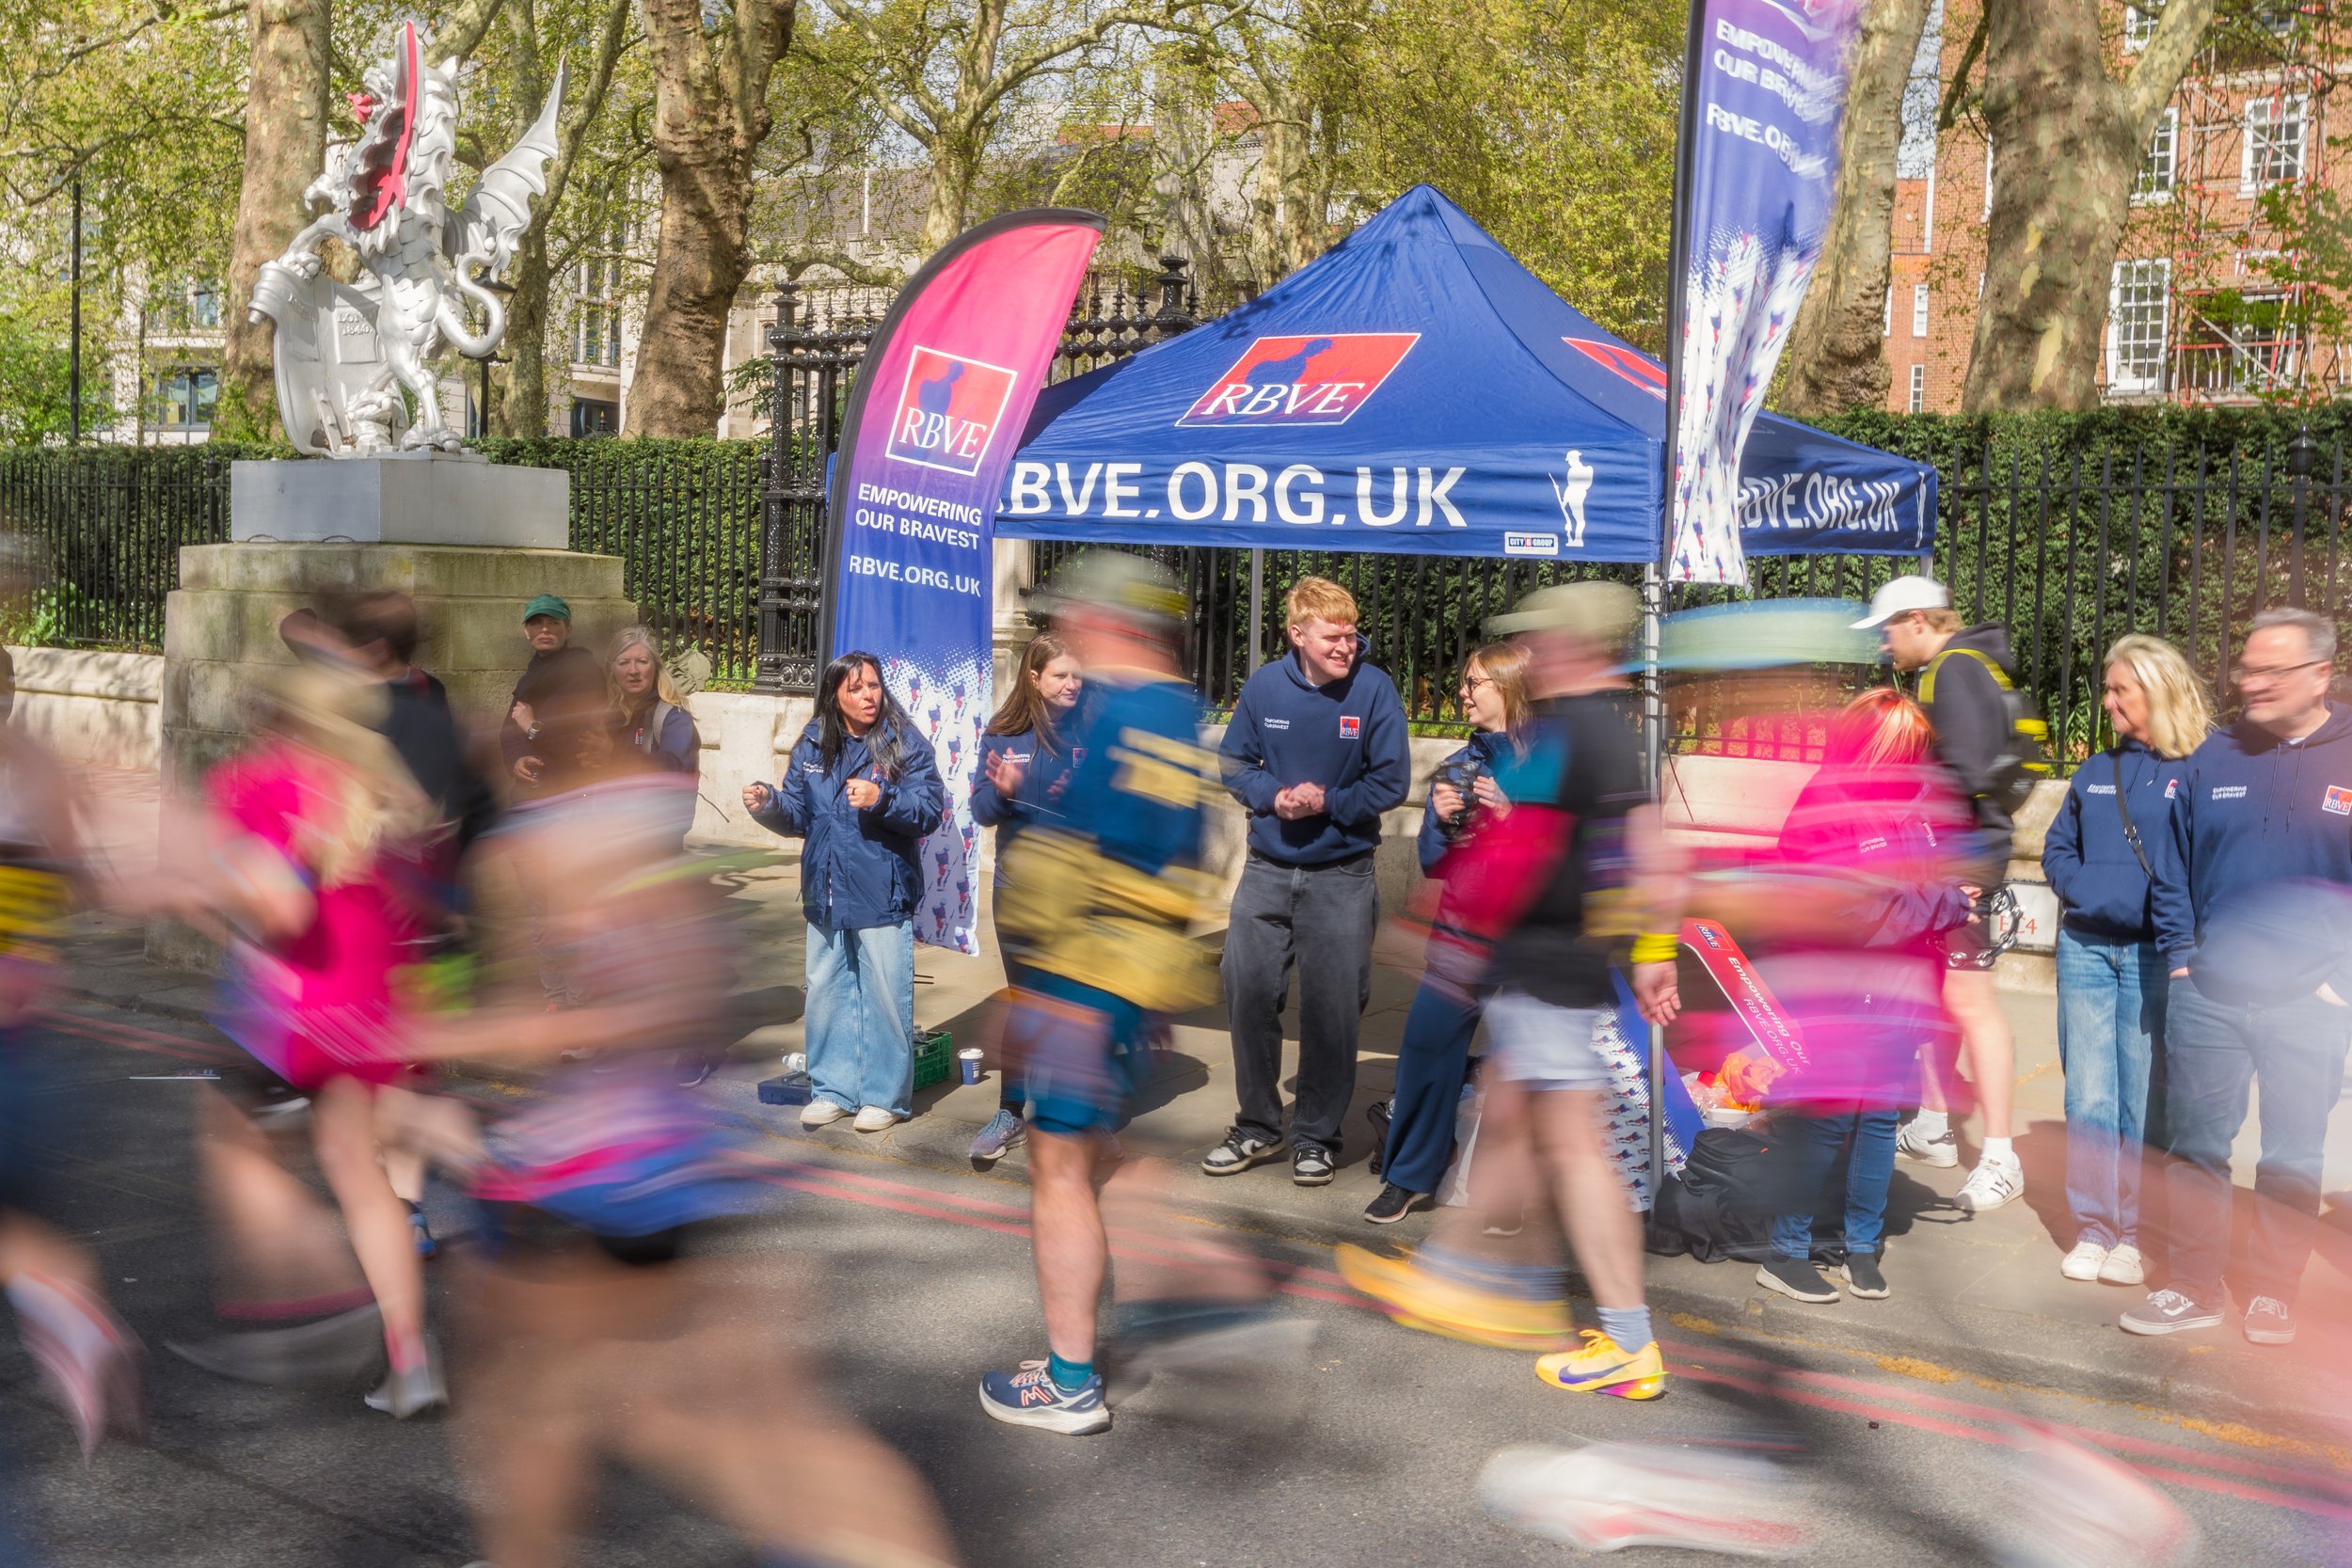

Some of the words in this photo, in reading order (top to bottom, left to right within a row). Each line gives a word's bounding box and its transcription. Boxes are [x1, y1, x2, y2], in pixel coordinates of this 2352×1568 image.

[1201, 383, 1365, 415] RBVE
[898, 405, 988, 459] RBVE
[857, 483, 983, 527] EMPOWERING
[996, 462, 1468, 527] BVE.ORG.UK
[855, 508, 896, 534] OUR
[899, 517, 979, 550] BRAVEST
[1509, 537, 1524, 546] CITY
[1533, 538, 1553, 547] GROUP
[849, 555, 981, 597] RBVE.ORG.UK
[2325, 797, 2350, 812] RBVE
[1698, 925, 1721, 949] RBVE
[1727, 956, 1791, 1037] Empowering
[1789, 1040, 1812, 1066] Our
[1743, 997, 1804, 1074] RBVE.ORG.UK
